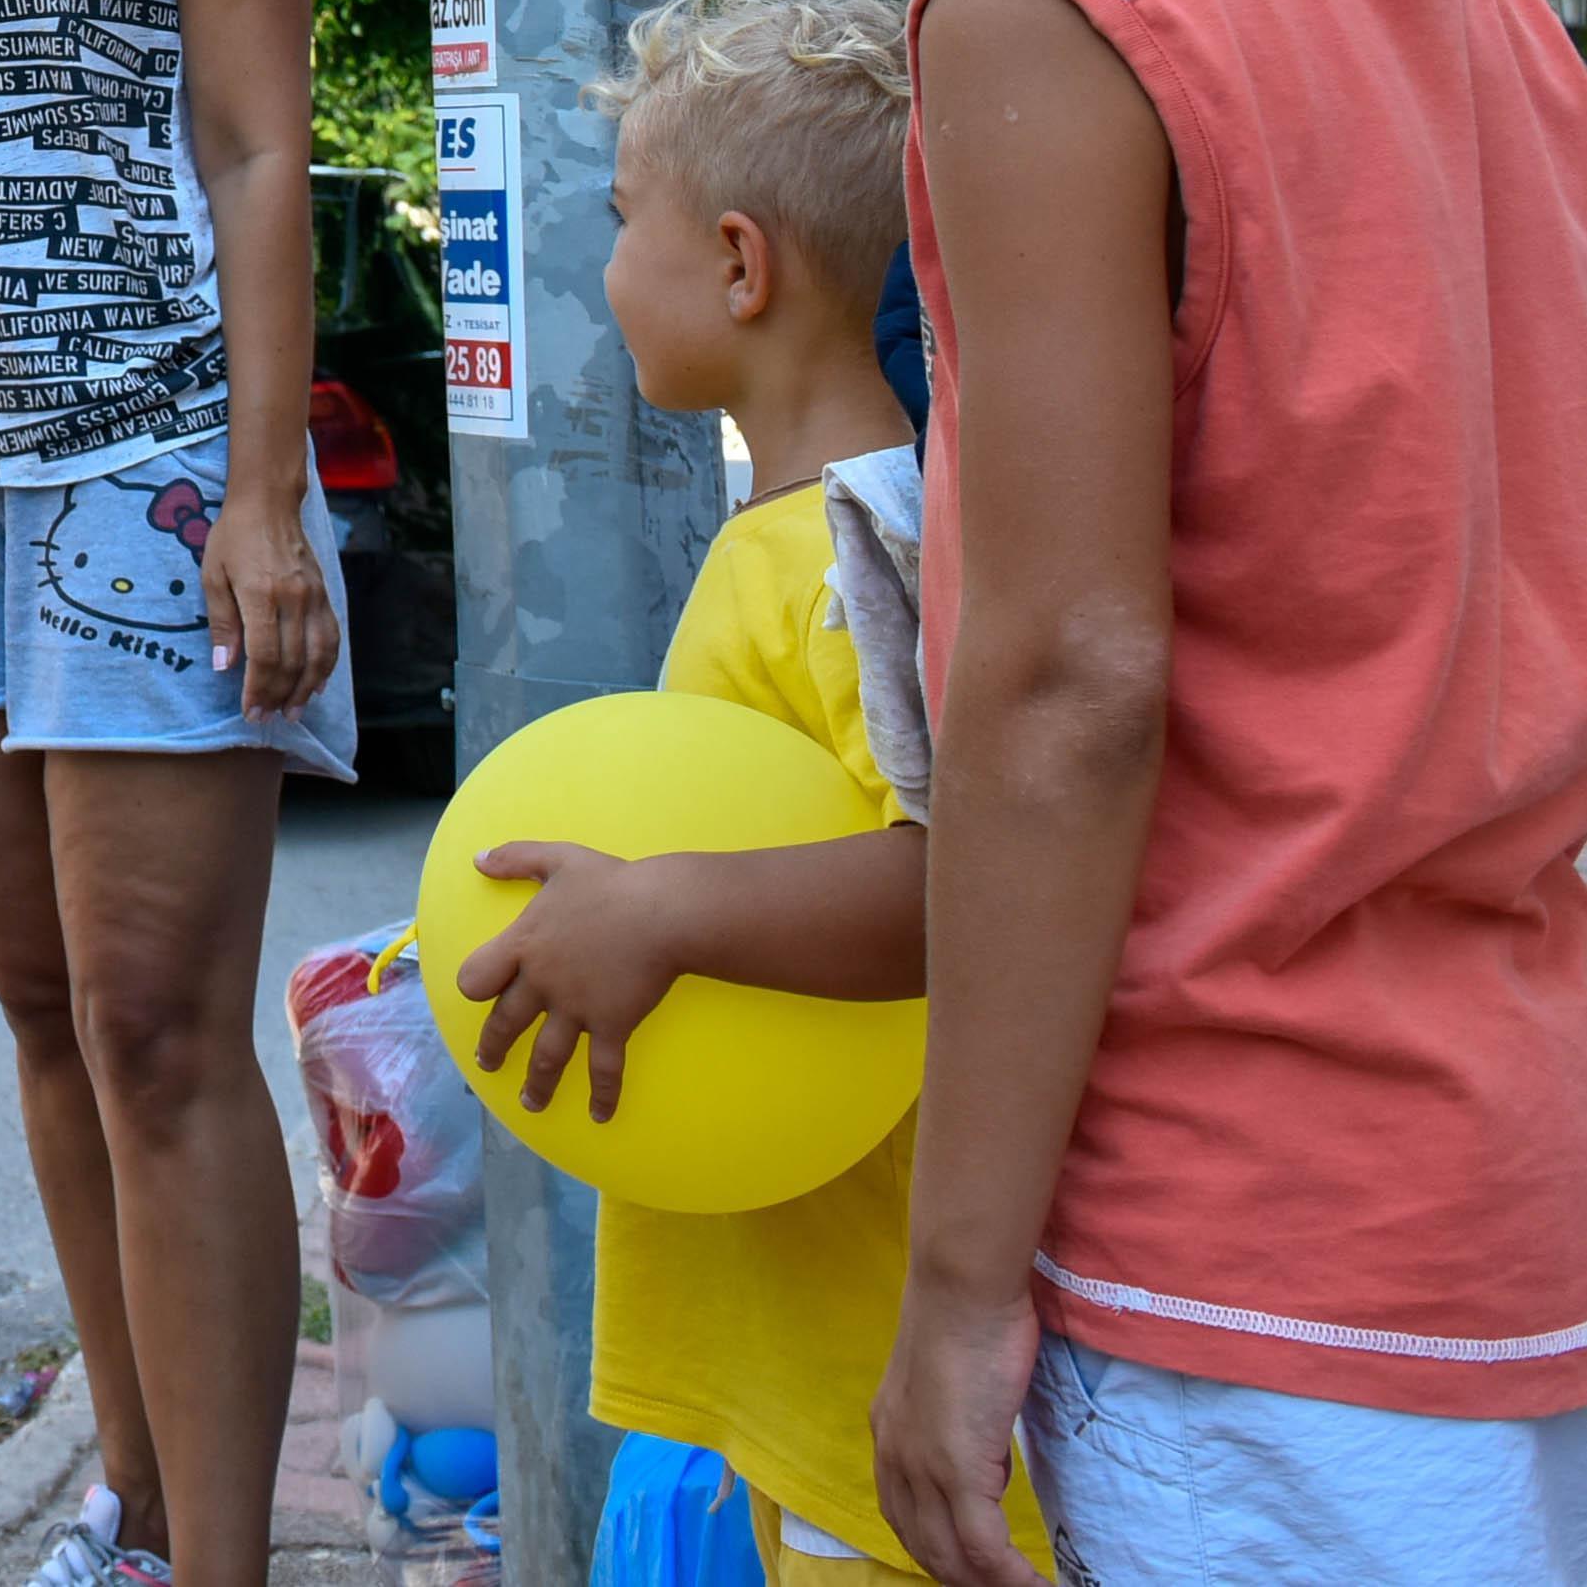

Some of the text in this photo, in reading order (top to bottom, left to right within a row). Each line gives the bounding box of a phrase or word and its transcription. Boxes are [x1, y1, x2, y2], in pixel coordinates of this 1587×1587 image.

[25, 69, 73, 90] WAVE
[42, 127, 89, 150] DEEPS
[59, 236, 104, 258] NEW
[105, 306, 160, 328] WAVE
[2, 355, 78, 375] SUMMER
[476, 346, 502, 384] 89
[22, 384, 77, 409] WAVE
[112, 407, 173, 440] OCEAN
[40, 606, 194, 673] Hello Kitty
